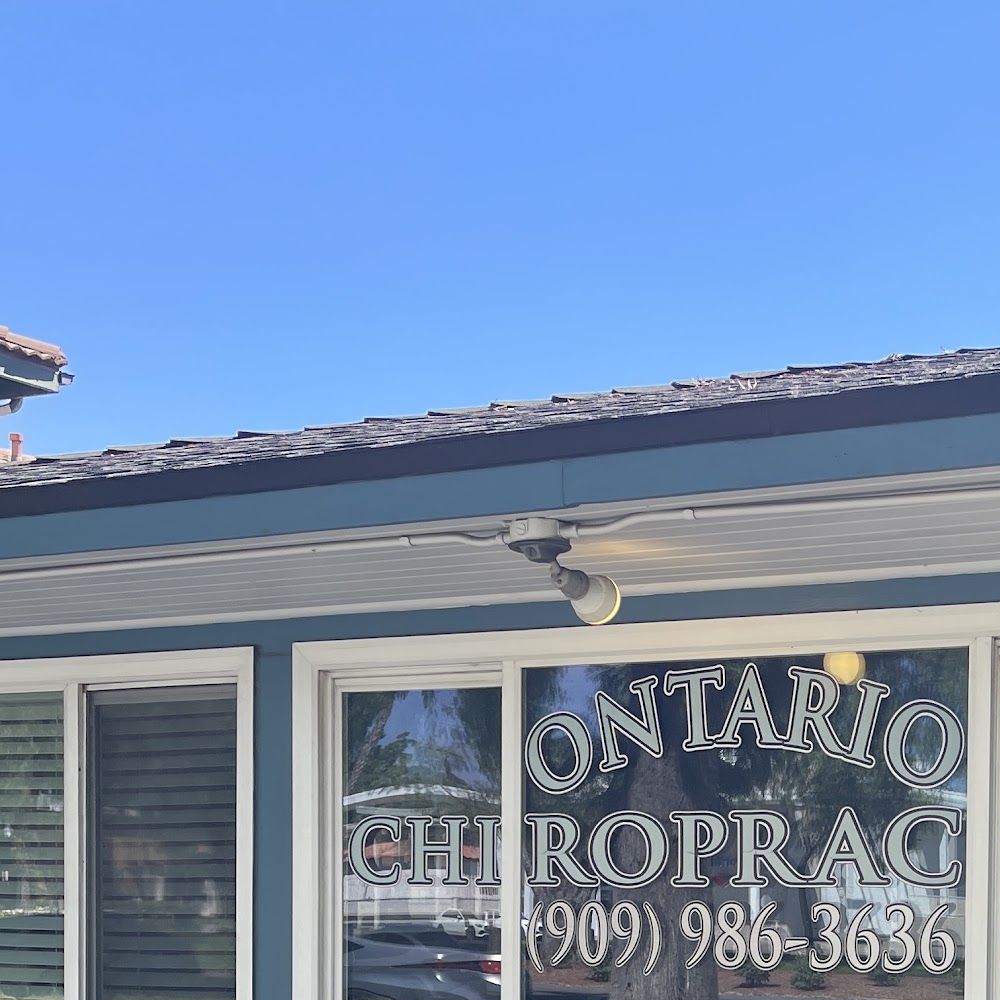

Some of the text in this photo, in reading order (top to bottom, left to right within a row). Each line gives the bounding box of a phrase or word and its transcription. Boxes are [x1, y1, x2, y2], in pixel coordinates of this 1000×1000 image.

[525, 662, 964, 794] ONTARIO
[525, 900, 956, 975] (909) 986-3636
